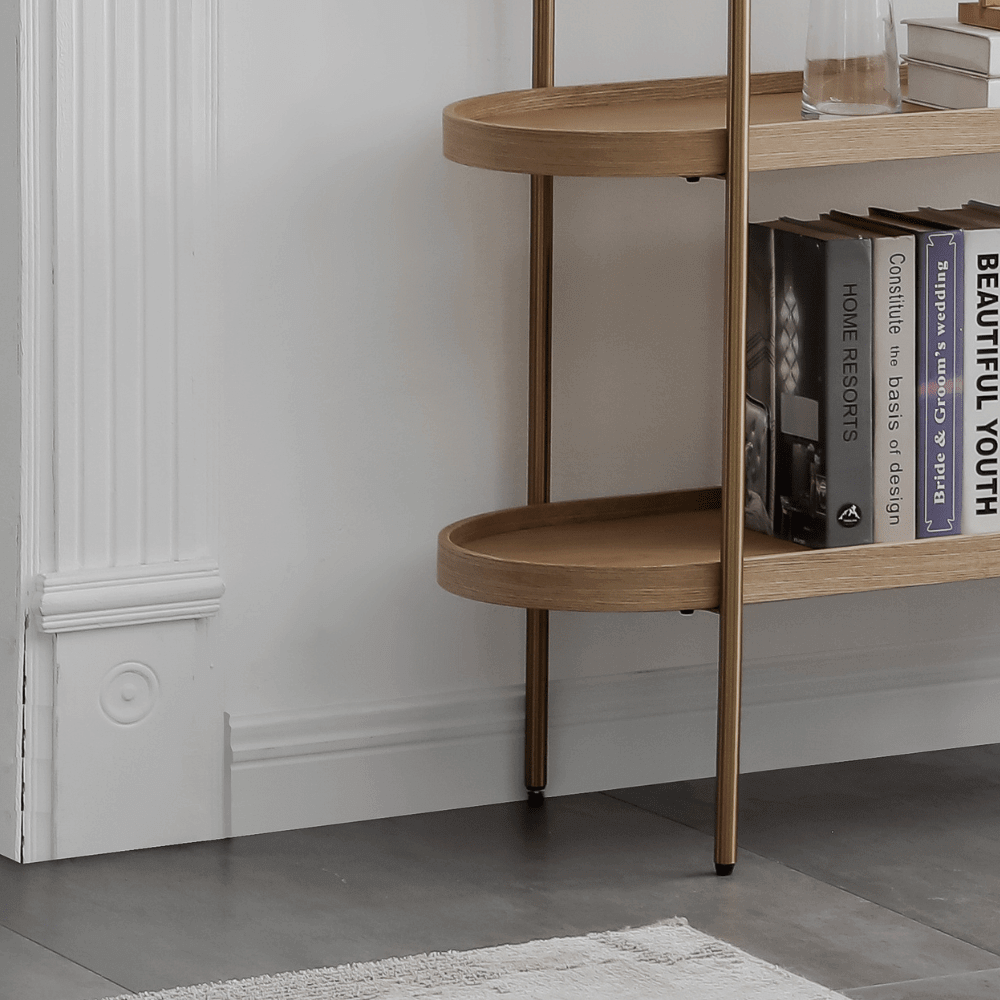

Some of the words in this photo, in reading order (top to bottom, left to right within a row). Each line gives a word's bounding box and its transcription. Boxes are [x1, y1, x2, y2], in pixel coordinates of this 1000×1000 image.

[842, 282, 858, 342] HOME
[888, 252, 906, 335] Constitute
[935, 260, 949, 336] wedding
[889, 346, 899, 367] the
[975, 253, 1000, 411] BEAUTIFUL
[842, 346, 858, 442] RESORTS
[888, 376, 904, 431] basis
[933, 341, 947, 426] Groom's
[888, 439, 902, 457] of
[933, 430, 947, 447] &
[975, 419, 999, 516] YOUTH
[886, 463, 903, 526] design
[933, 451, 946, 505] Bride
